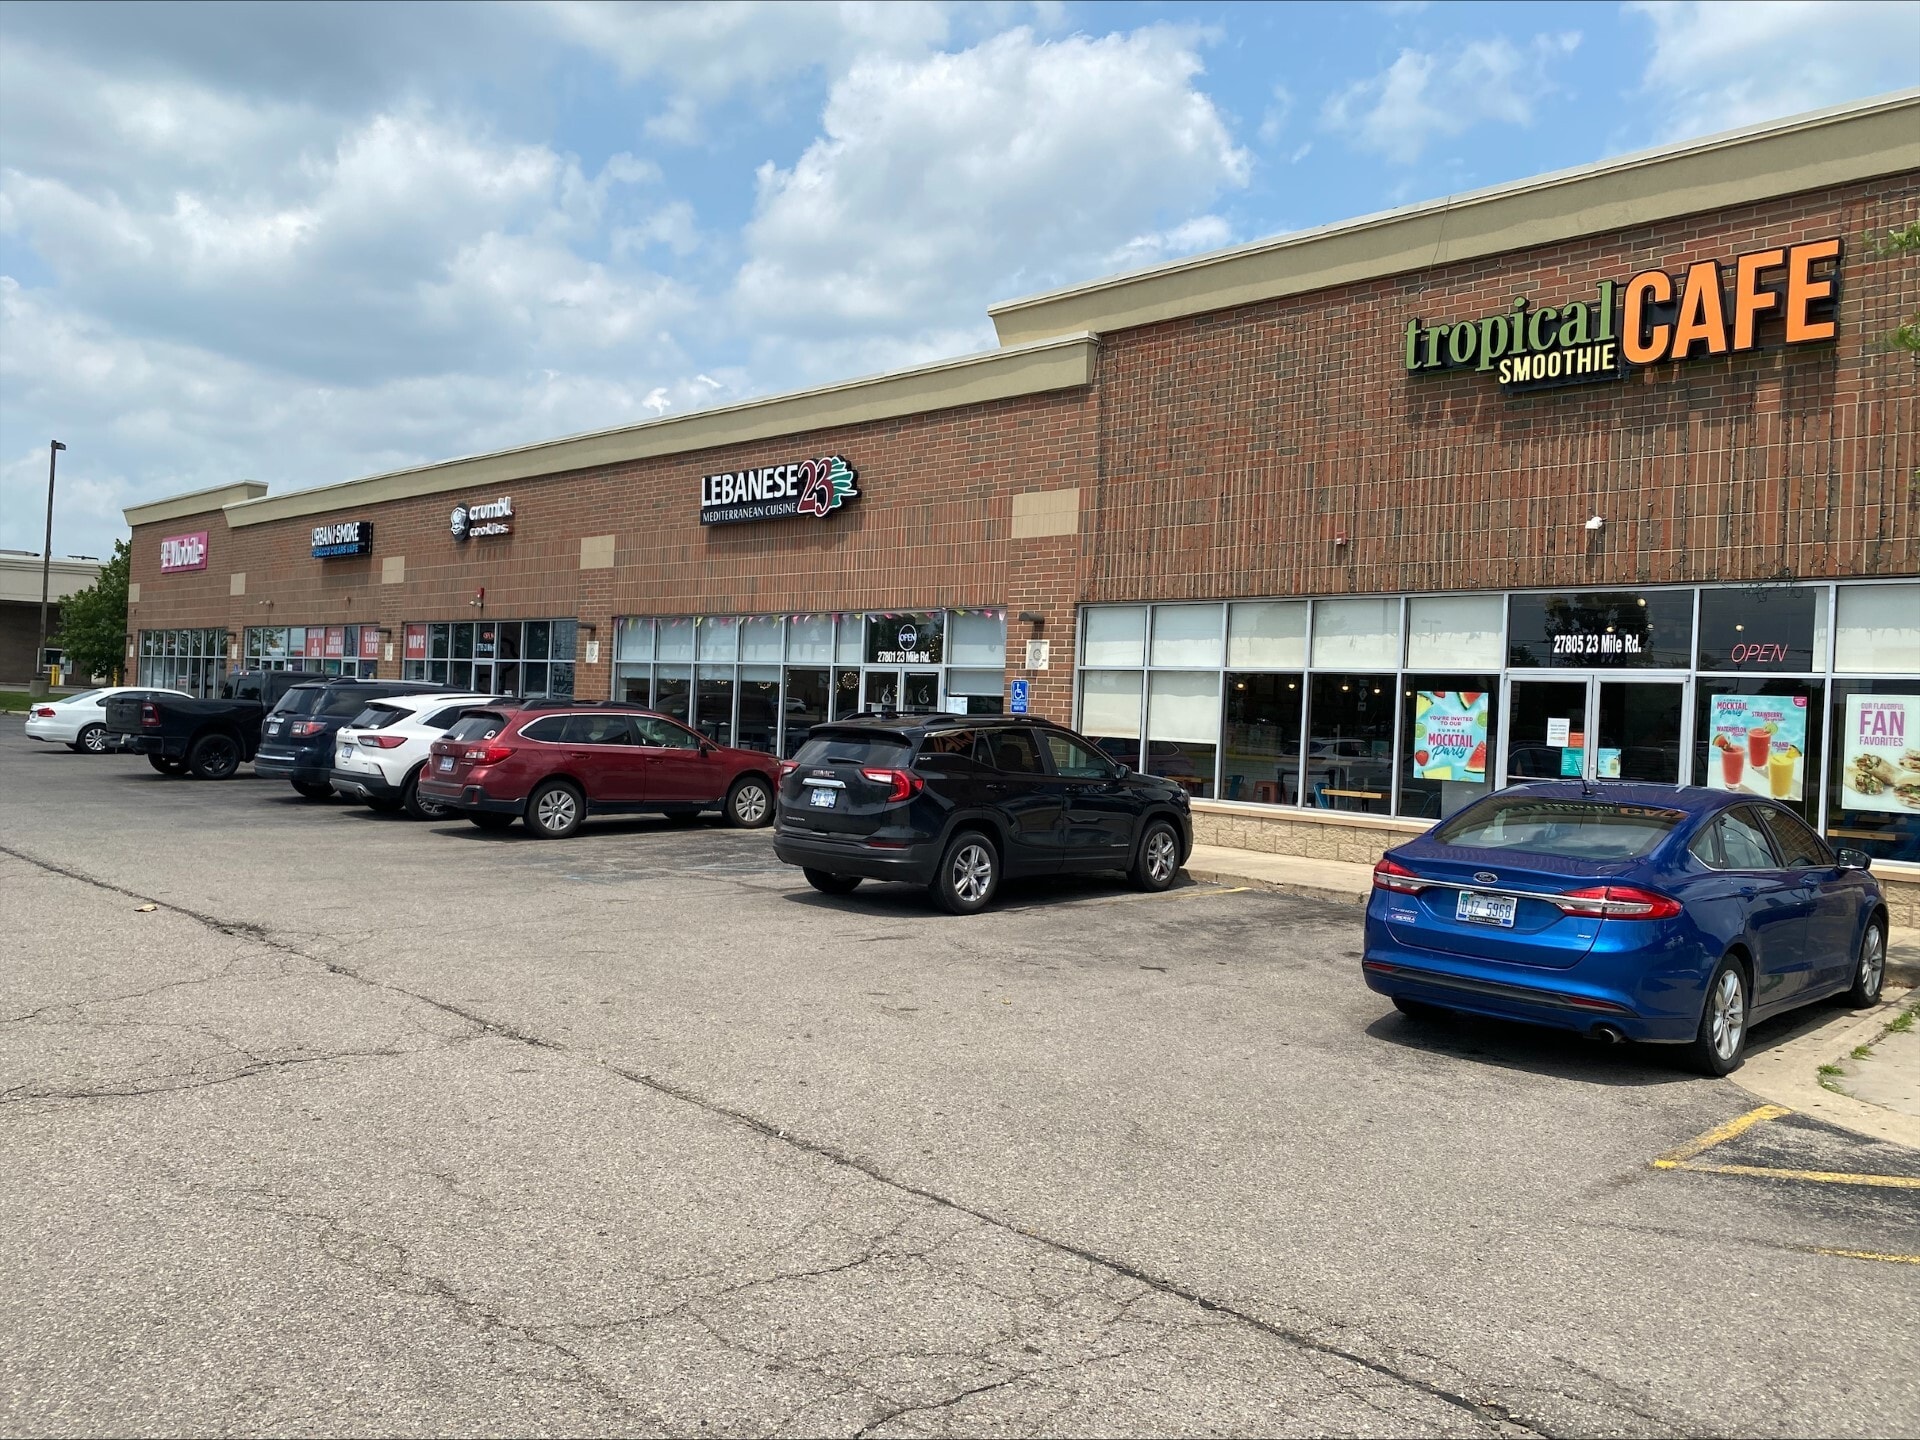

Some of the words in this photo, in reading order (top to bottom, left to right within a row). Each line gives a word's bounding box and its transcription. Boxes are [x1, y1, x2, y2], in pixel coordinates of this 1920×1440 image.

[1404, 280, 1615, 371] tropical
[1622, 239, 1841, 364] CAFE
[1499, 343, 1615, 384] SMOOTHIE
[702, 464, 798, 507] LEBANESE
[797, 456, 833, 518] 23
[469, 496, 513, 520] crumbl
[703, 506, 764, 523] MEDITERRANEAN
[765, 502, 796, 516] CUISINE
[336, 521, 360, 543] SMOKE
[469, 522, 509, 537] cookies
[408, 635, 425, 649] VAPE
[899, 633, 917, 642] OPEN
[1553, 634, 1584, 654] 27805
[1585, 634, 1599, 654] 23
[1600, 634, 1623, 654] Mile
[1624, 634, 1642, 654] Rd.
[877, 651, 896, 663] 27801
[896, 651, 906, 663] 23
[905, 651, 919, 663] Mile
[919, 651, 931, 663] Rd.
[1731, 643, 1789, 662] OPEN
[1716, 702, 1748, 710] MOCKTAIL
[1751, 711, 1783, 719] STRAWBERRY
[1860, 710, 1905, 737] FAN
[1428, 733, 1474, 748] MOCKTAIL
[1859, 736, 1904, 747] FAVORITES
[1431, 744, 1467, 761] Party
[1460, 900, 1480, 914] DJZ
[1486, 902, 1512, 918] 5968
